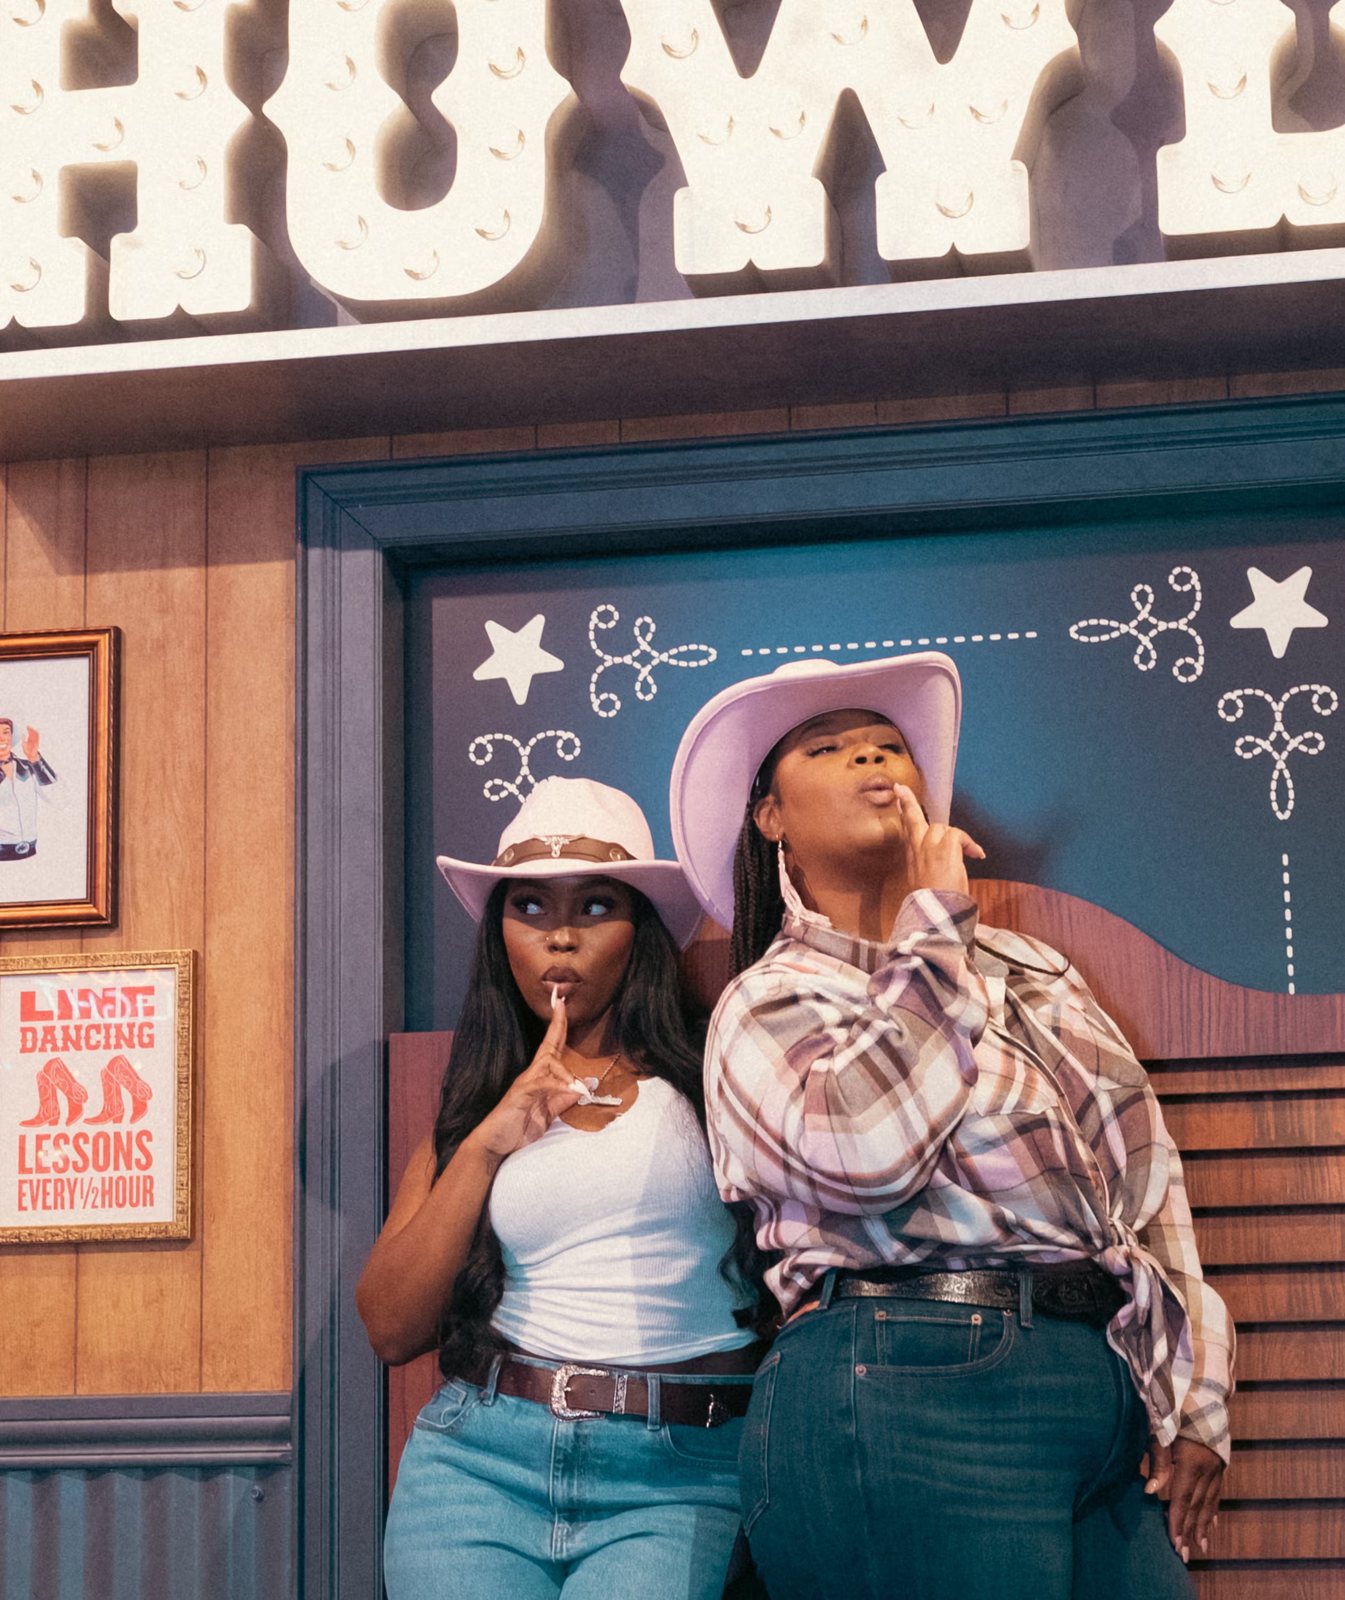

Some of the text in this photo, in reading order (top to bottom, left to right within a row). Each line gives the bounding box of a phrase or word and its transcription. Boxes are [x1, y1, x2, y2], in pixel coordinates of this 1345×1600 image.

[20, 985, 155, 1022] LINE
[19, 1020, 155, 1054] DANCING
[18, 1129, 154, 1175] LESSONS
[17, 1177, 78, 1211] EVERY
[100, 1175, 155, 1209] HOUR
